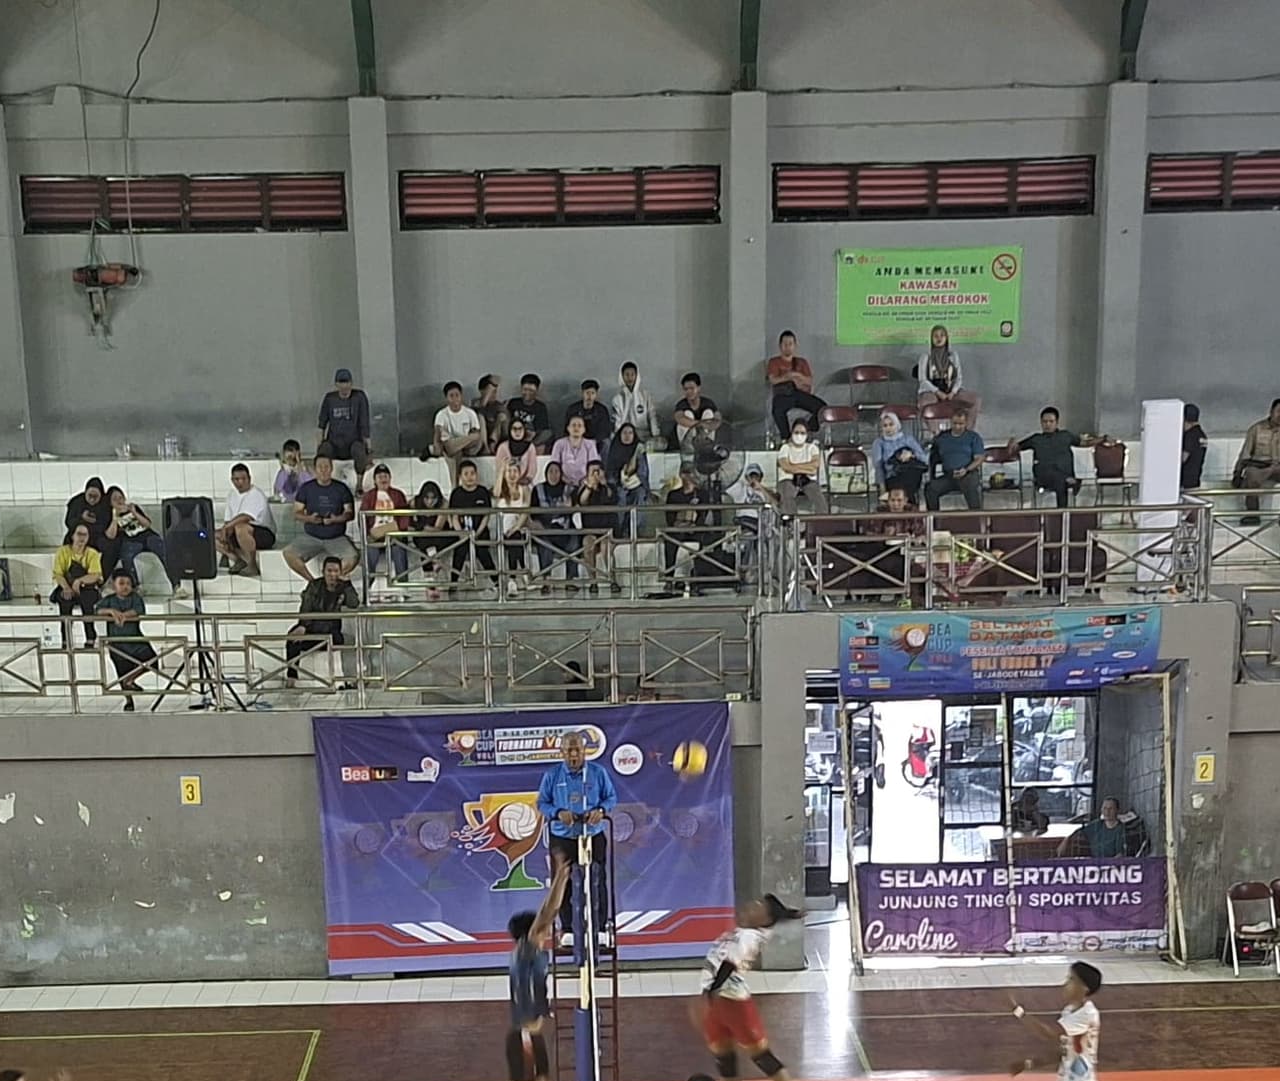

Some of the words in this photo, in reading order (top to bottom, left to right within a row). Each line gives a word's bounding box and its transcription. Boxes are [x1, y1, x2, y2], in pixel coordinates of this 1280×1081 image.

[875, 265, 910, 276] ANDA
[915, 265, 984, 275] MEMASUKI
[900, 280, 957, 290] KAWASAN
[868, 295, 927, 305] DILARANG
[930, 294, 989, 304] MEROKOK
[929, 623, 951, 635] BEA
[970, 619, 1054, 630] SELAMAT
[969, 630, 1056, 641] DATANG
[928, 639, 952, 650] CUP
[1041, 655, 1054, 668] 17
[476, 741, 495, 751] CUP
[341, 767, 370, 781] Bea
[1200, 762, 1209, 779] 2
[186, 784, 195, 801] 3
[880, 869, 987, 888] SELAMAT
[993, 865, 1142, 886] BERTANDING
[879, 895, 958, 909] JUNJUNG
[1029, 892, 1142, 907] SPORTIVITAS
[864, 917, 958, 953] Caroline
